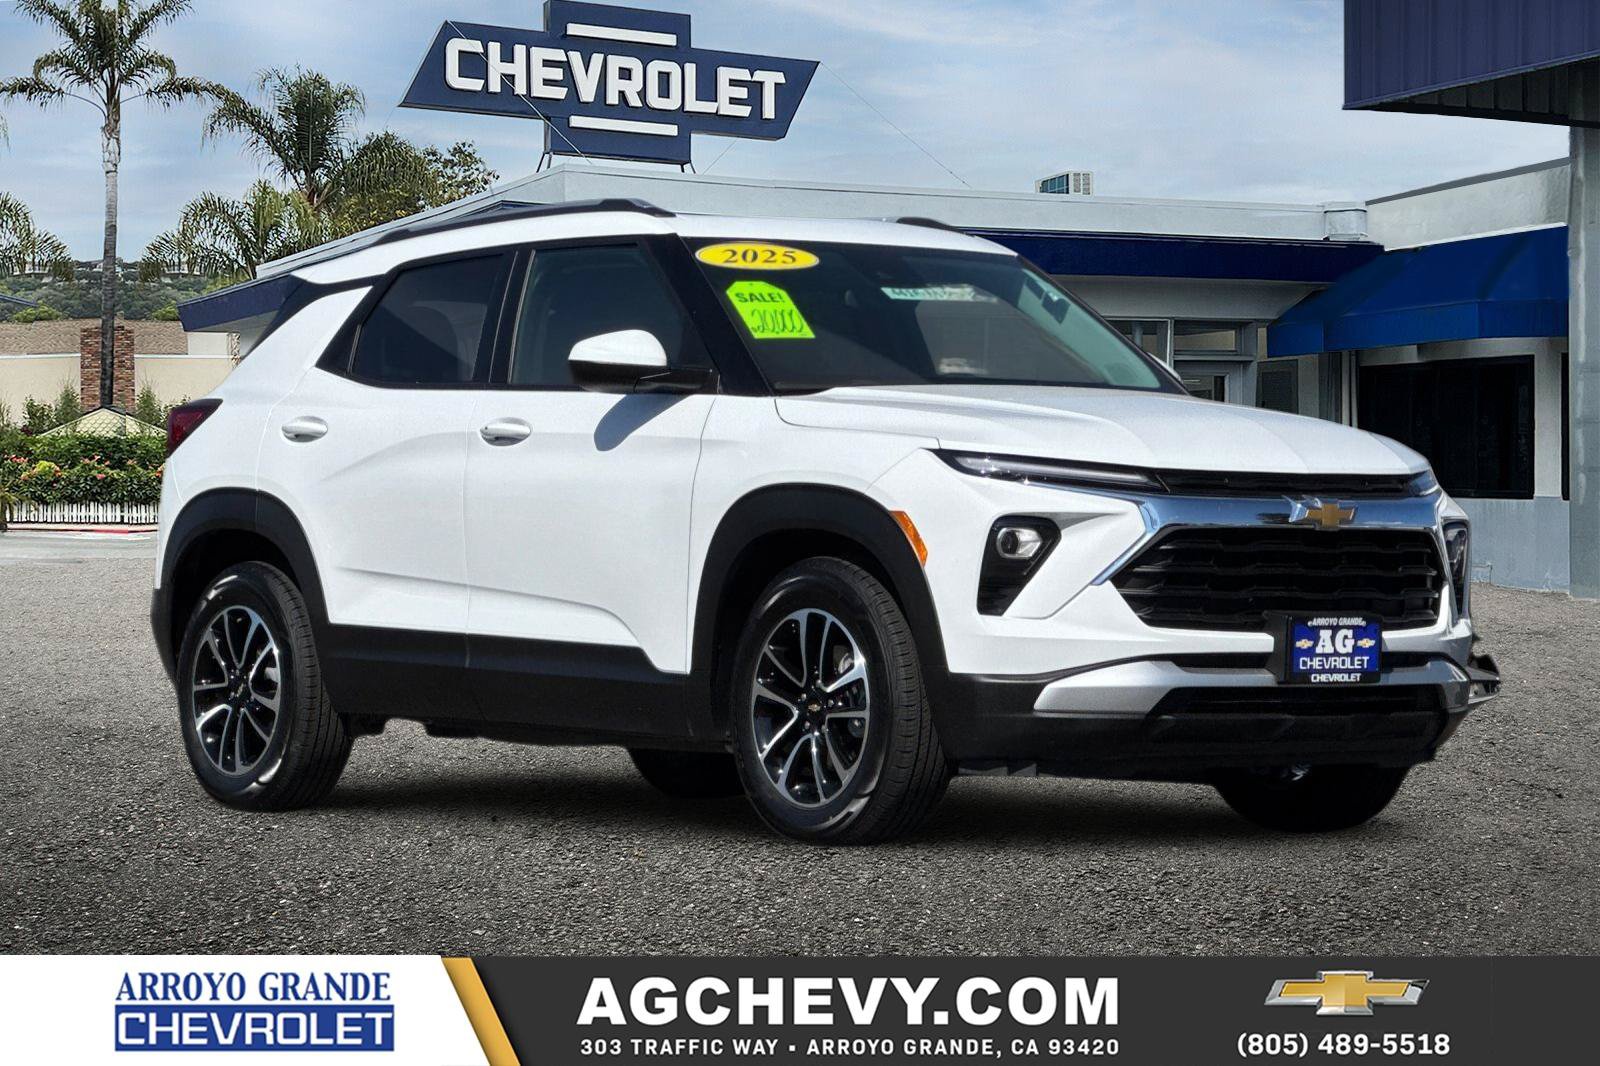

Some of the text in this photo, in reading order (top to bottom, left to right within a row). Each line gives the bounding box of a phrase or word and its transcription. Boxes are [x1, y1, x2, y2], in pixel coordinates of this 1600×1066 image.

[445, 37, 787, 120] CHEVROLET
[722, 249, 796, 264] 2025
[735, 292, 785, 303] SALE!
[1312, 618, 1337, 627] ARROYO
[1315, 628, 1355, 654] AG
[1299, 656, 1370, 669] CHEVROLET
[1311, 673, 1361, 683] CHEVROLET
